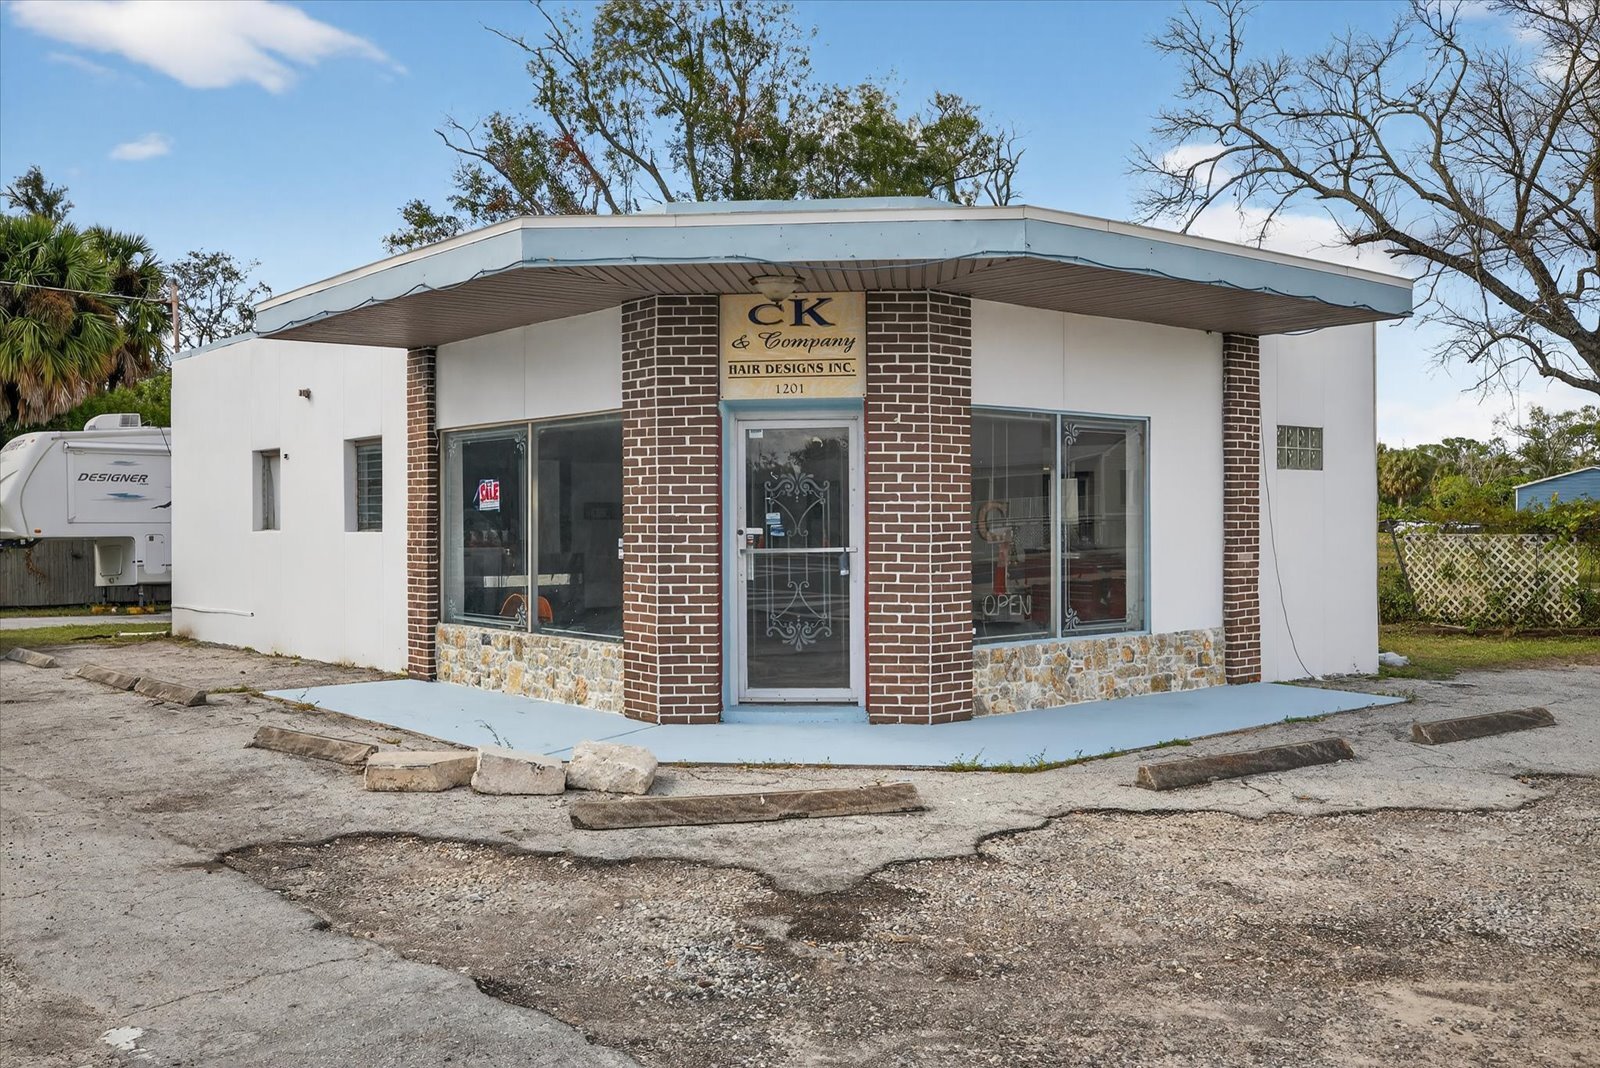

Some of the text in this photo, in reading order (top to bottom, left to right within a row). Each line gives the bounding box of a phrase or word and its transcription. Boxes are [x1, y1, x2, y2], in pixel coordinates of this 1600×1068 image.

[748, 297, 836, 327] CK
[731, 331, 856, 354] & Company
[728, 362, 856, 375] HAIR DESIGNS INC.
[776, 383, 805, 394] 1201
[77, 472, 149, 483] DESIGNER
[984, 594, 1032, 616] OPEN
